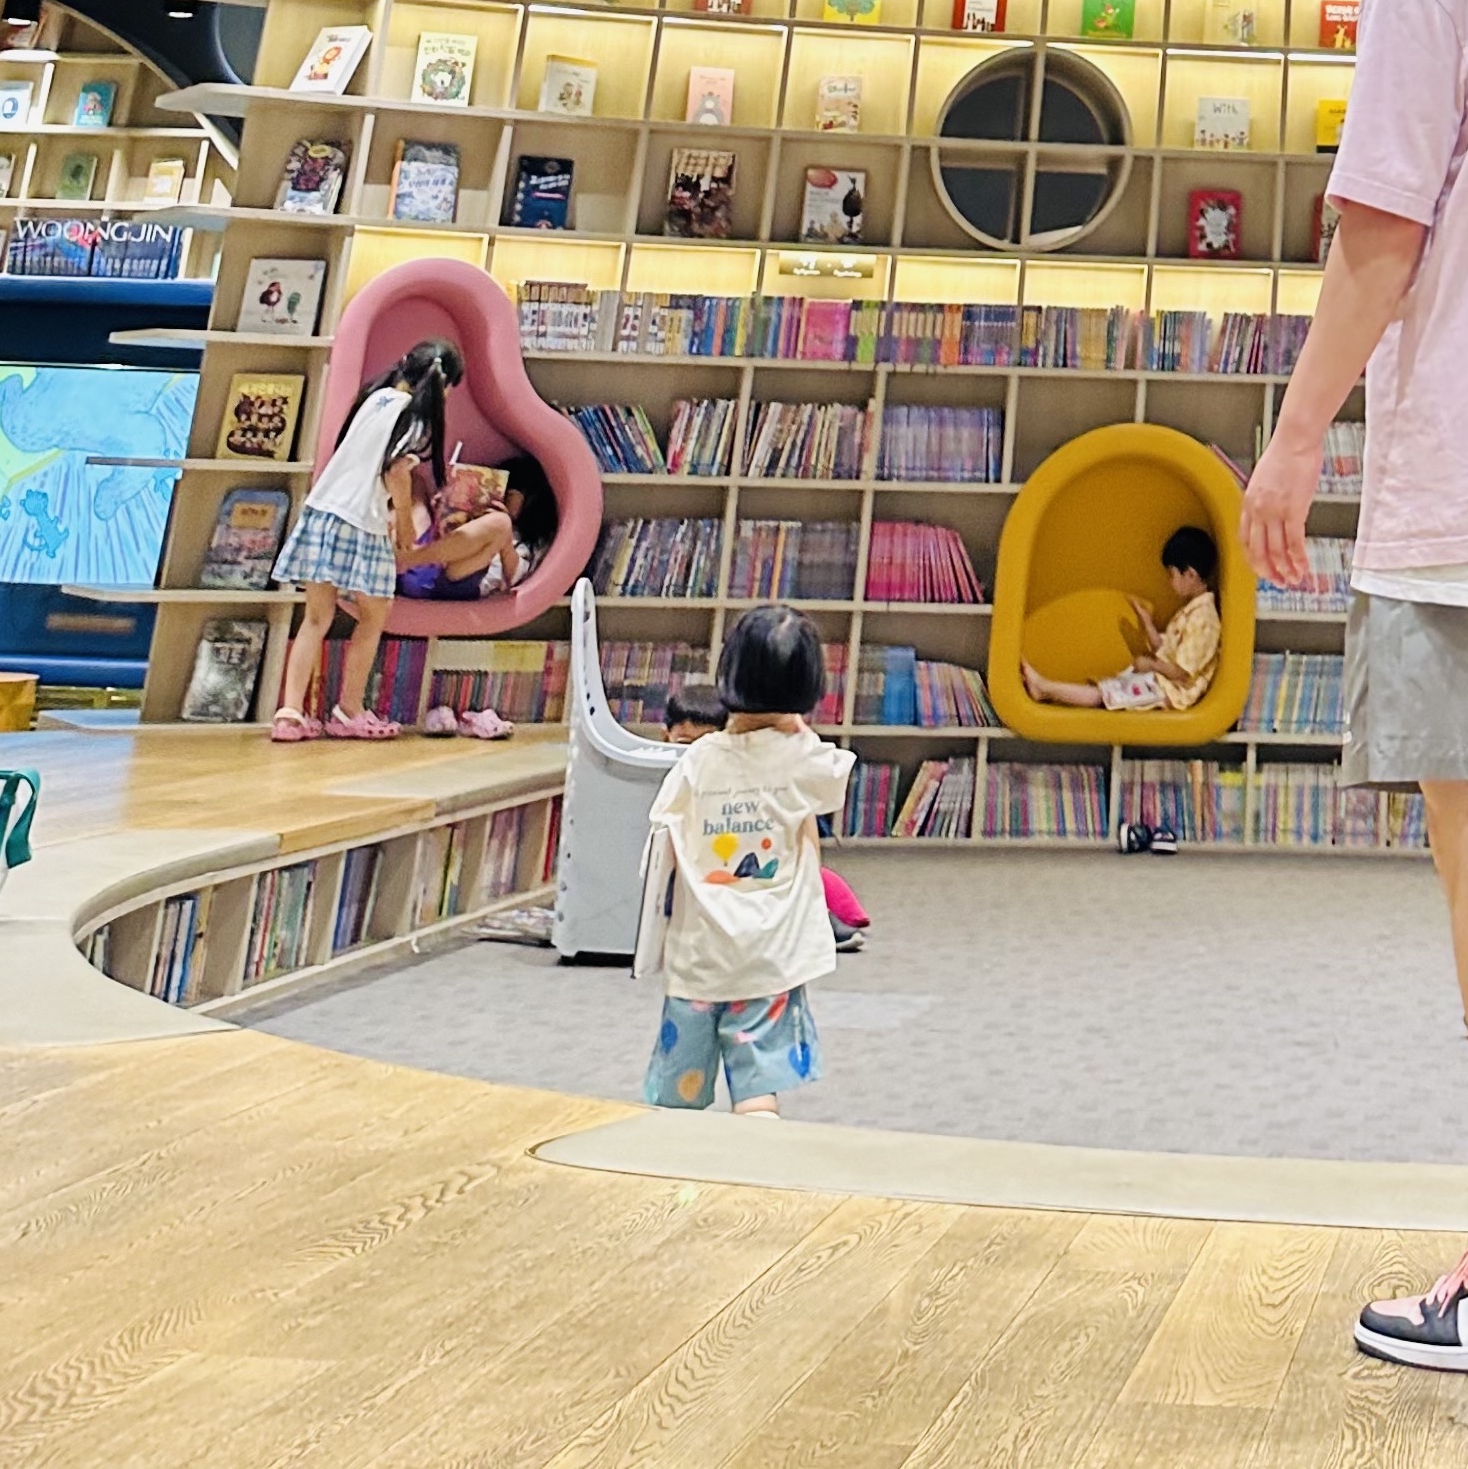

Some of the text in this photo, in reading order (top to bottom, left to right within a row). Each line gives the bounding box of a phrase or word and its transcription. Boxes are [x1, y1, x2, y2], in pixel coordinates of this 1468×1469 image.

[1213, 103, 1238, 115] With
[15, 217, 174, 244] WOONGJIN
[722, 800, 760, 816] new
[703, 816, 775, 836] balance
